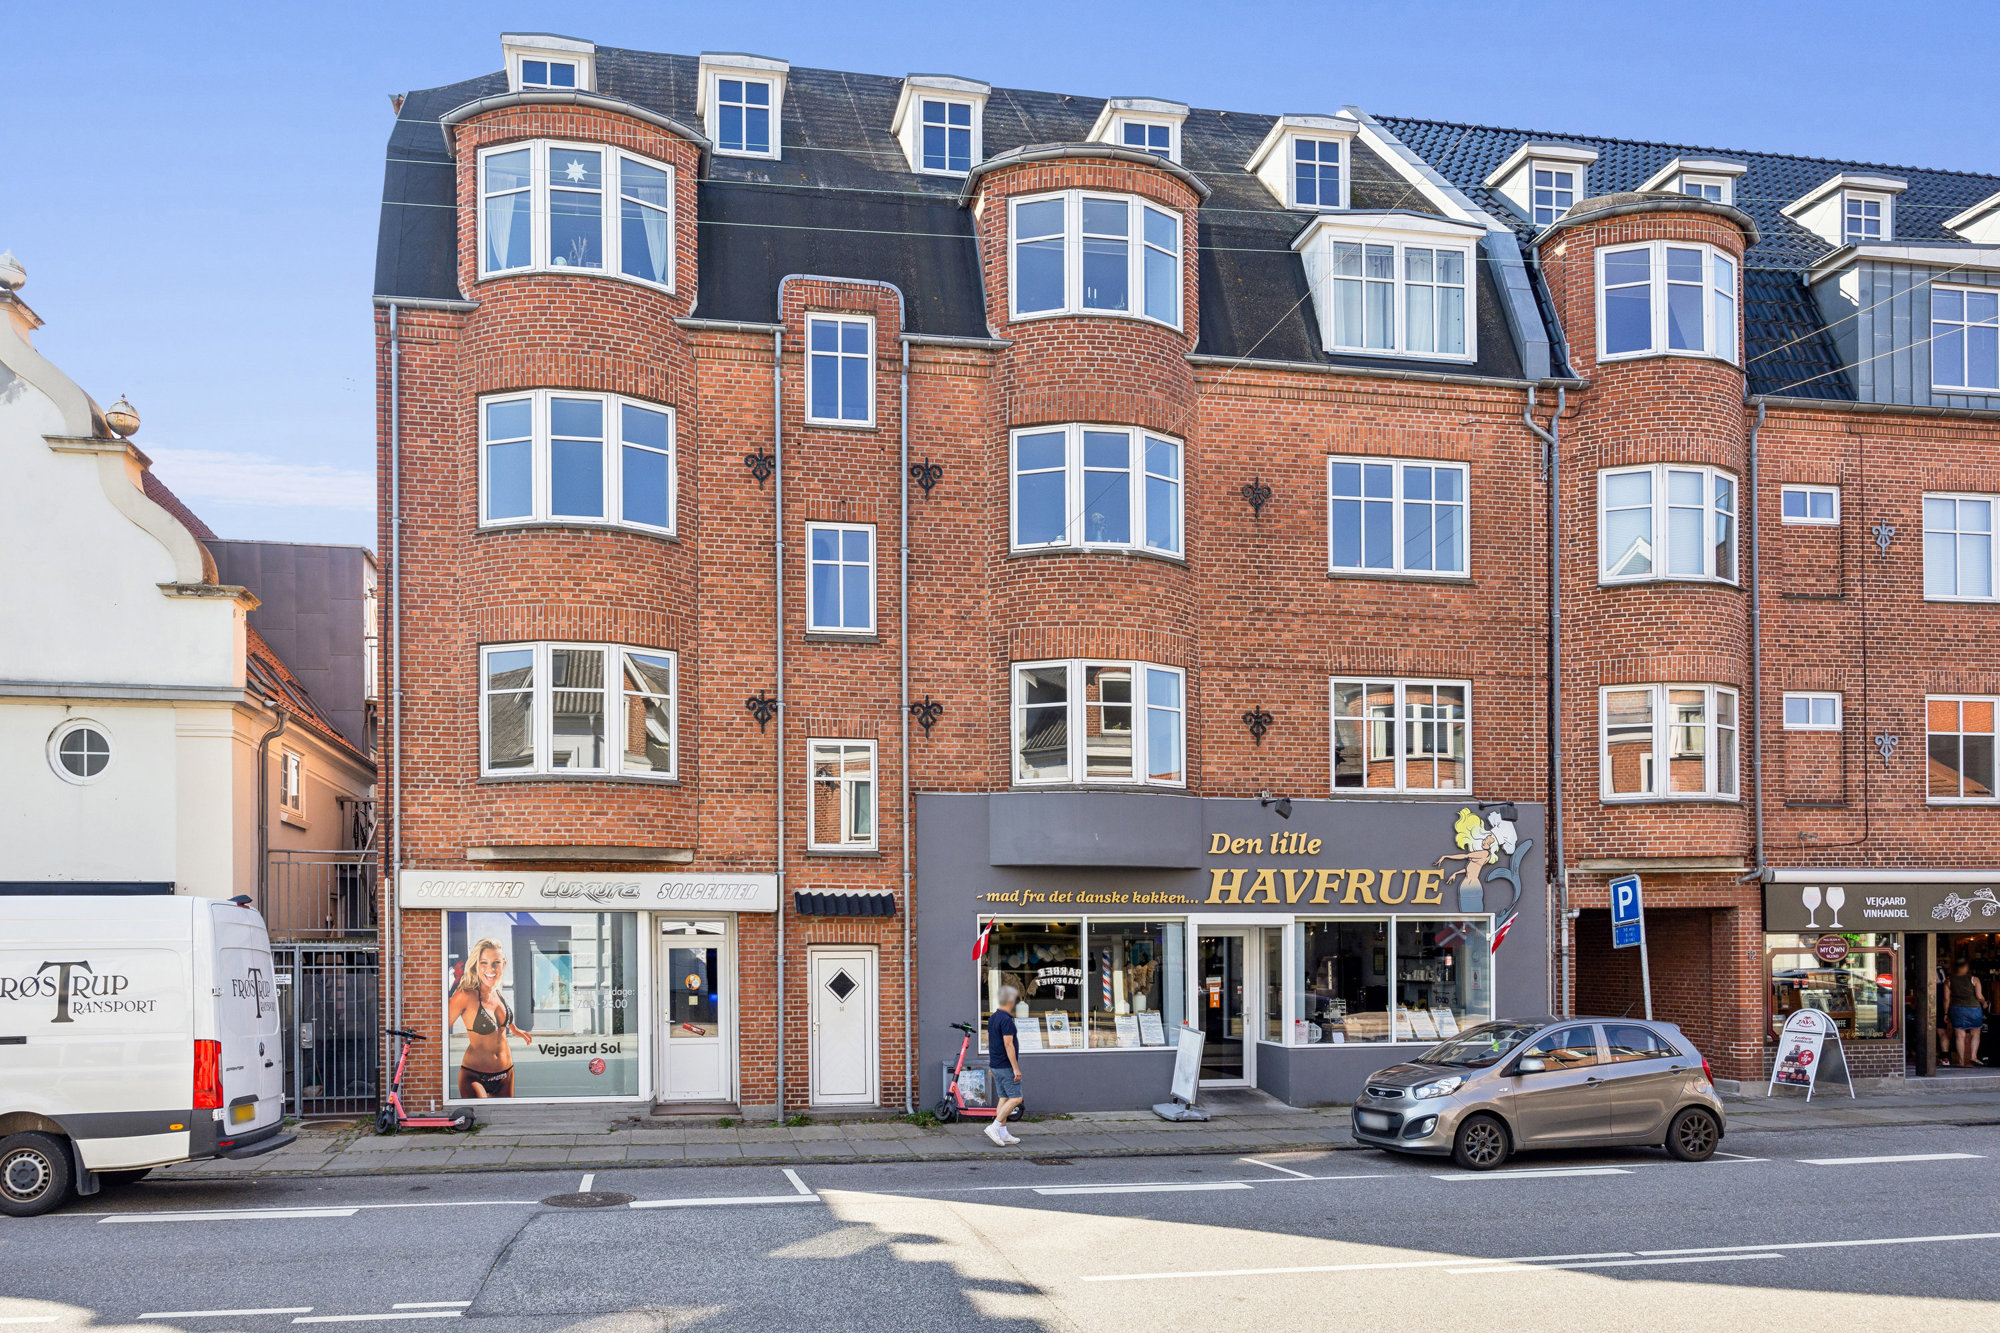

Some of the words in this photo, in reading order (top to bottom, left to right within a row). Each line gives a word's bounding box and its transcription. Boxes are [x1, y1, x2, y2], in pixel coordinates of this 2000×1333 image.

[1208, 833, 1264, 855] Den
[1270, 831, 1322, 855] lille
[417, 880, 525, 899] SOLCENTER
[540, 876, 642, 905] Luxura
[657, 882, 760, 900] SOLCENTER
[1204, 868, 1445, 905] HAVFRUE
[986, 889, 1019, 902] mad
[1019, 889, 1046, 906] fra
[1049, 890, 1074, 903] det
[1076, 890, 1128, 904] danske
[1132, 891, 1199, 905] køkken...
[1617, 885, 1633, 918] P
[1865, 896, 1906, 908] VEJGAARD
[1863, 909, 1910, 918] VINHANDEL
[538, 1042, 597, 1057] Vejgaard
[600, 1042, 622, 1054] Sol
